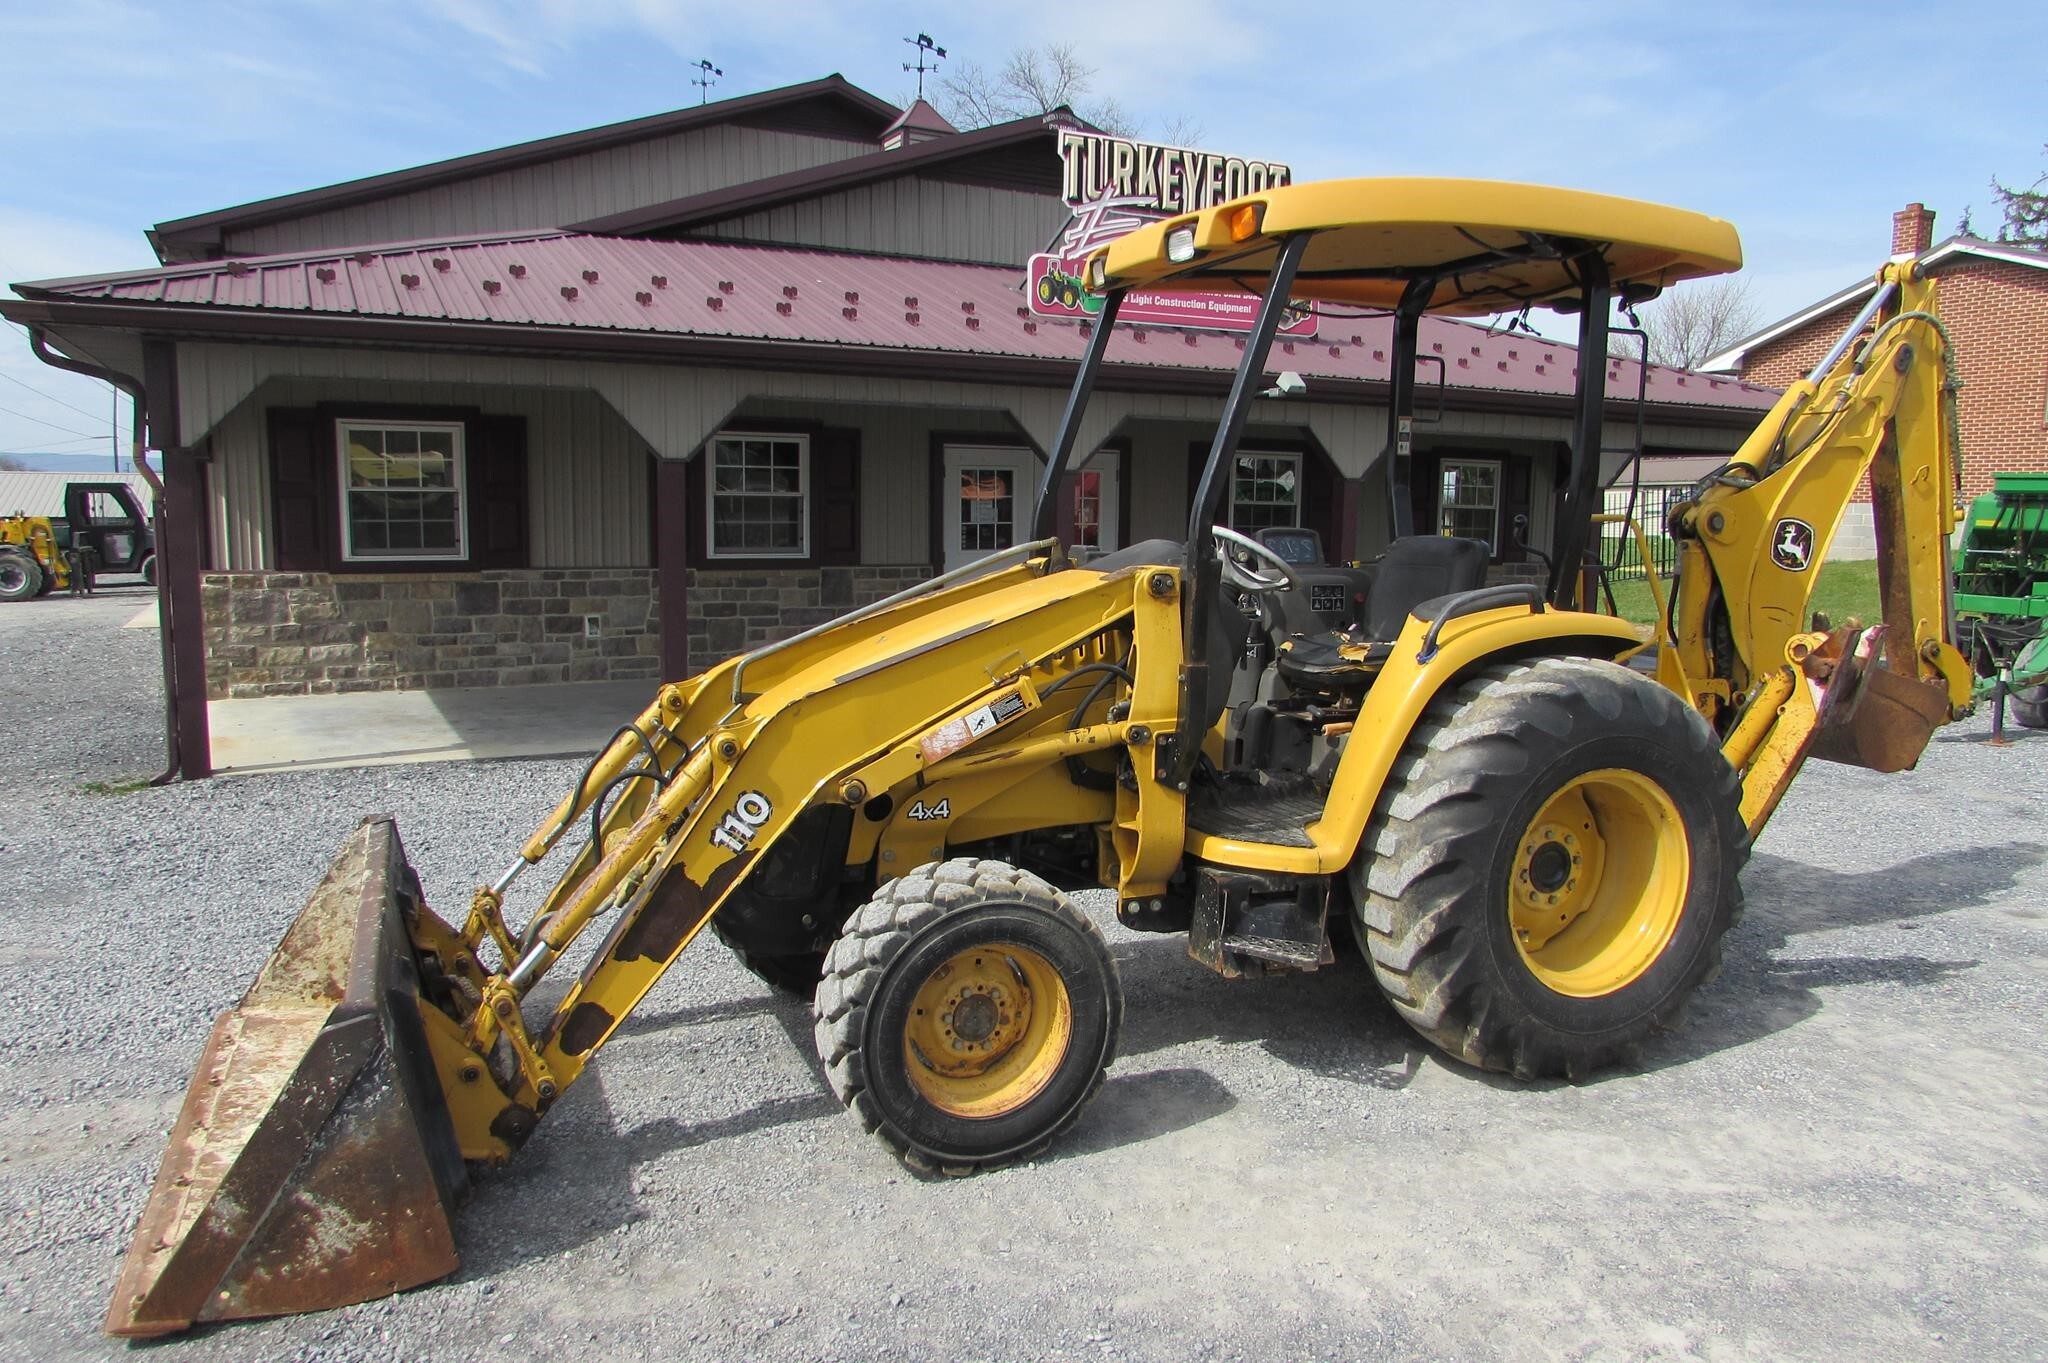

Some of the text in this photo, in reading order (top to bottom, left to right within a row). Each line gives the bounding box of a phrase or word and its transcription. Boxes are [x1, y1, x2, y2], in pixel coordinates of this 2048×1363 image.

[1130, 293, 1153, 306] Light
[1154, 295, 1206, 310] Construction
[1208, 300, 1252, 314] Equipment
[907, 798, 950, 821] 4x4
[711, 790, 773, 854] 110
